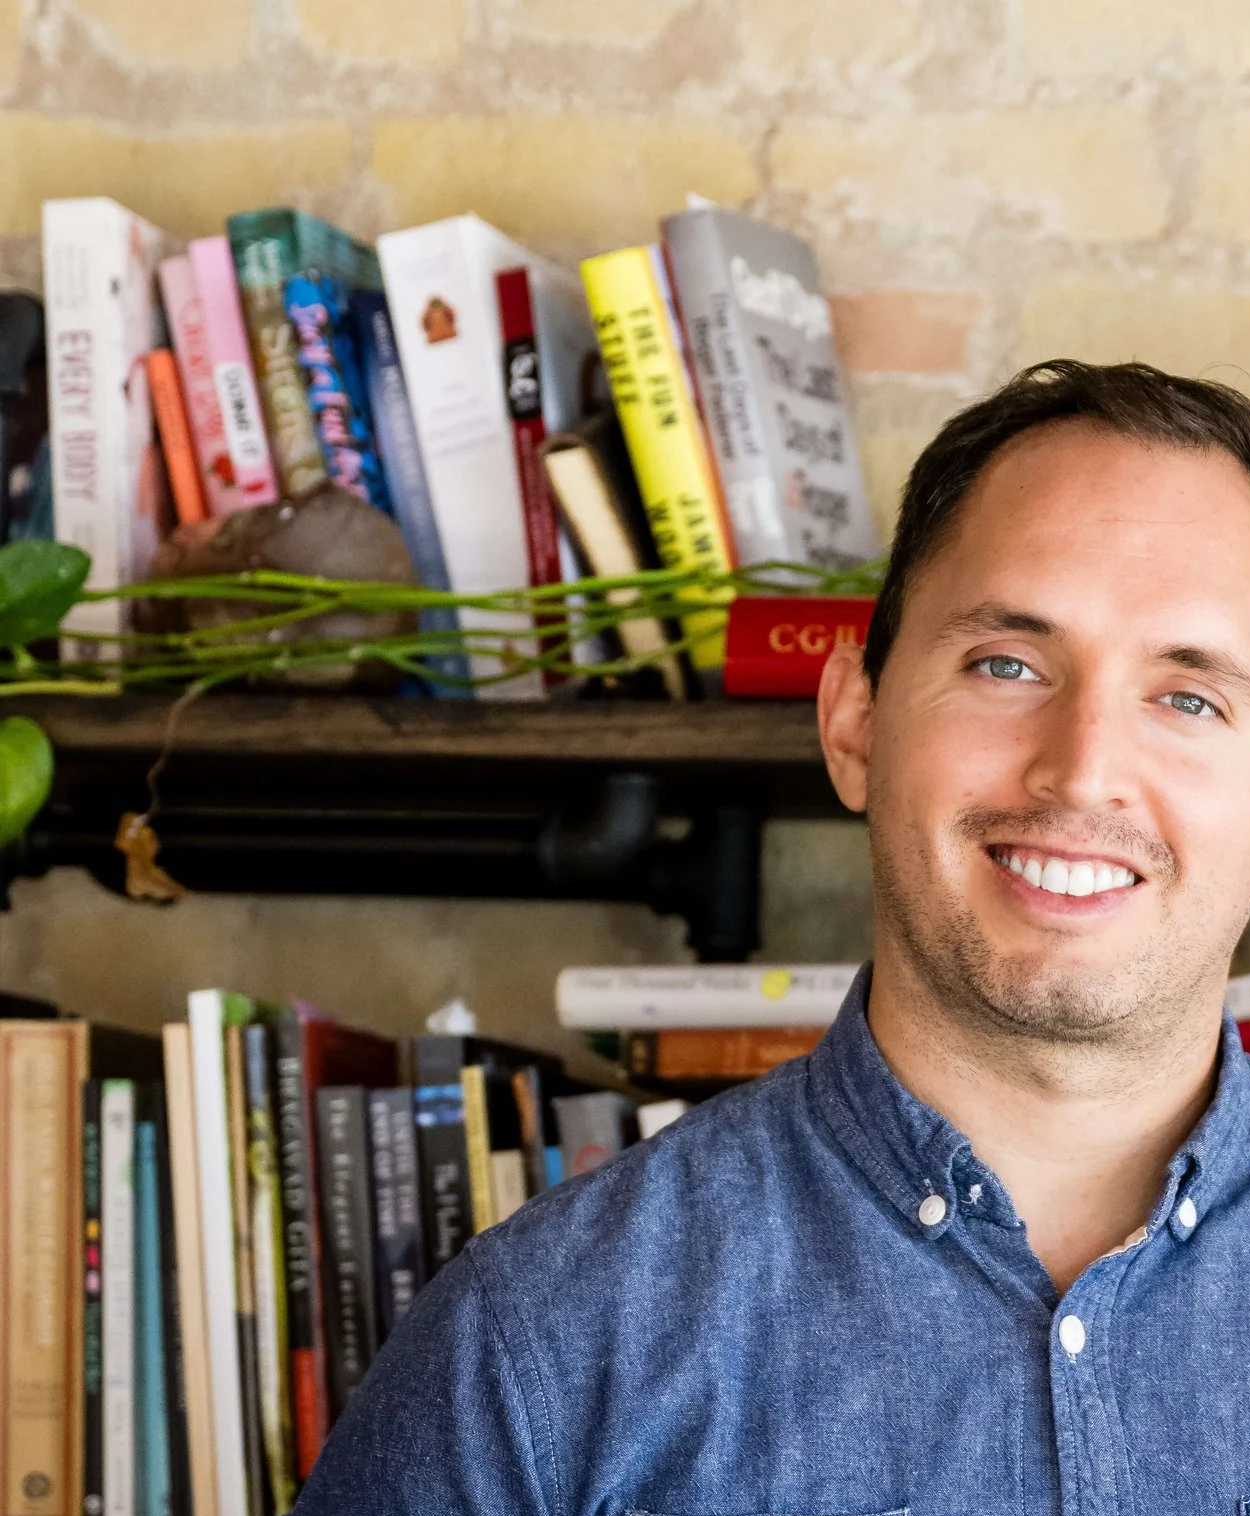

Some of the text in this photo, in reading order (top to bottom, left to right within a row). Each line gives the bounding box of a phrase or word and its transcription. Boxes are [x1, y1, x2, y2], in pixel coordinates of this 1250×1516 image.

[58, 331, 93, 416] EVERY
[626, 304, 679, 430] THE FUN
[62, 429, 99, 504] BODY
